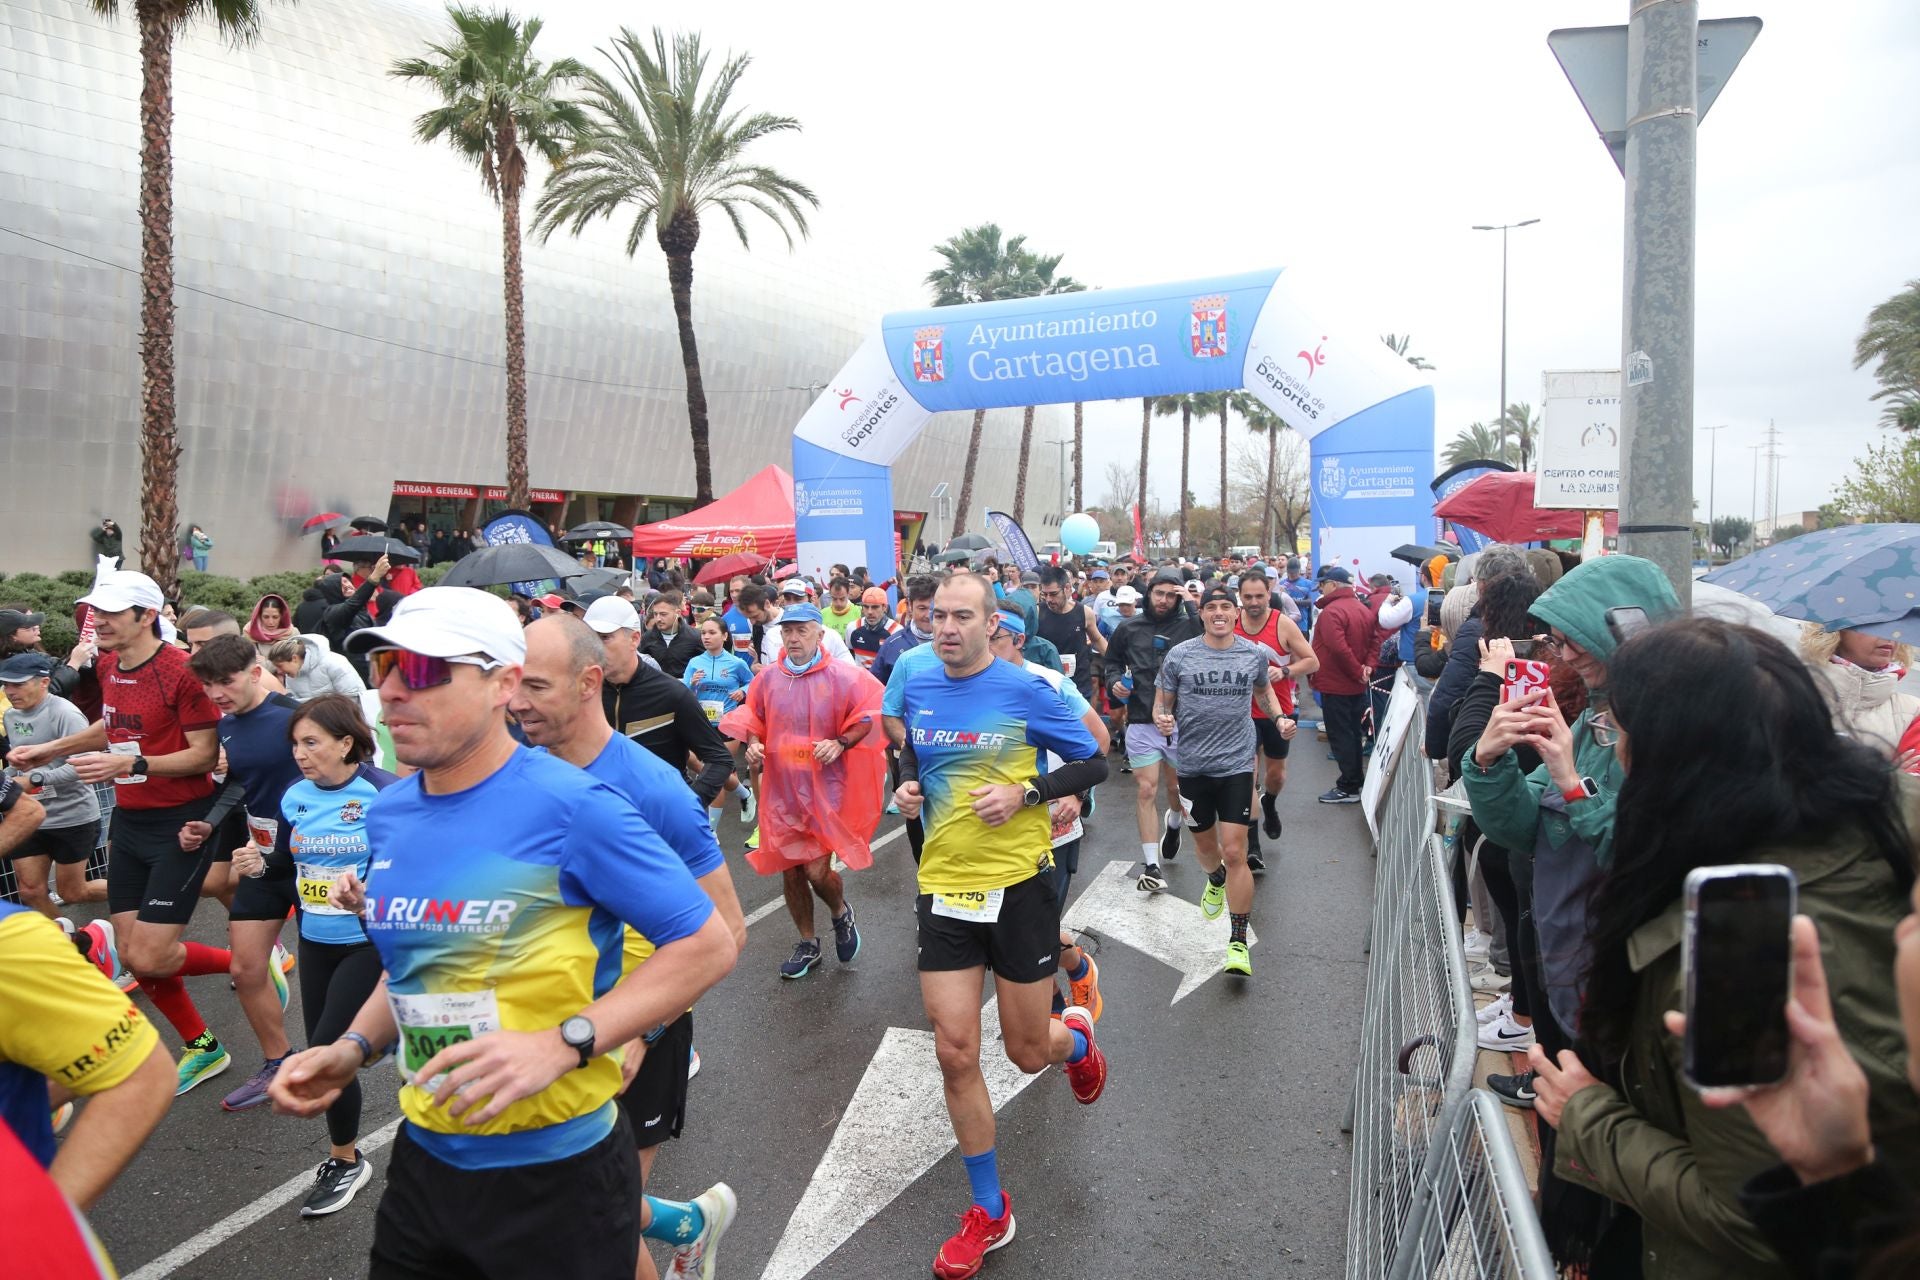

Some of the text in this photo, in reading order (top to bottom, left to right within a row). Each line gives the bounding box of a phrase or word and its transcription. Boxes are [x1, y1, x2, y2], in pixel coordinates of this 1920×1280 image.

[968, 310, 1157, 349] Ayuntamiento
[968, 342, 1160, 382] Cartagena
[877, 388, 889, 400] de
[1256, 362, 1318, 420] Deportes
[1311, 397, 1326, 410] de
[1587, 398, 1621, 406] CART
[847, 394, 898, 448] Deportes
[1348, 464, 1415, 477] Ayuntamiento
[1543, 469, 1585, 478] CENTRO
[1348, 475, 1414, 489] Cartagena
[392, 483, 474, 496] ENTRADA GENERAL
[810, 488, 862, 498] Ayuntamiento
[810, 496, 862, 509] Cartagena
[1193, 670, 1248, 687] UCAM
[395, 922, 416, 930] TEAM
[419, 923, 443, 932] POZO
[447, 924, 510, 933] ESTRECHO
